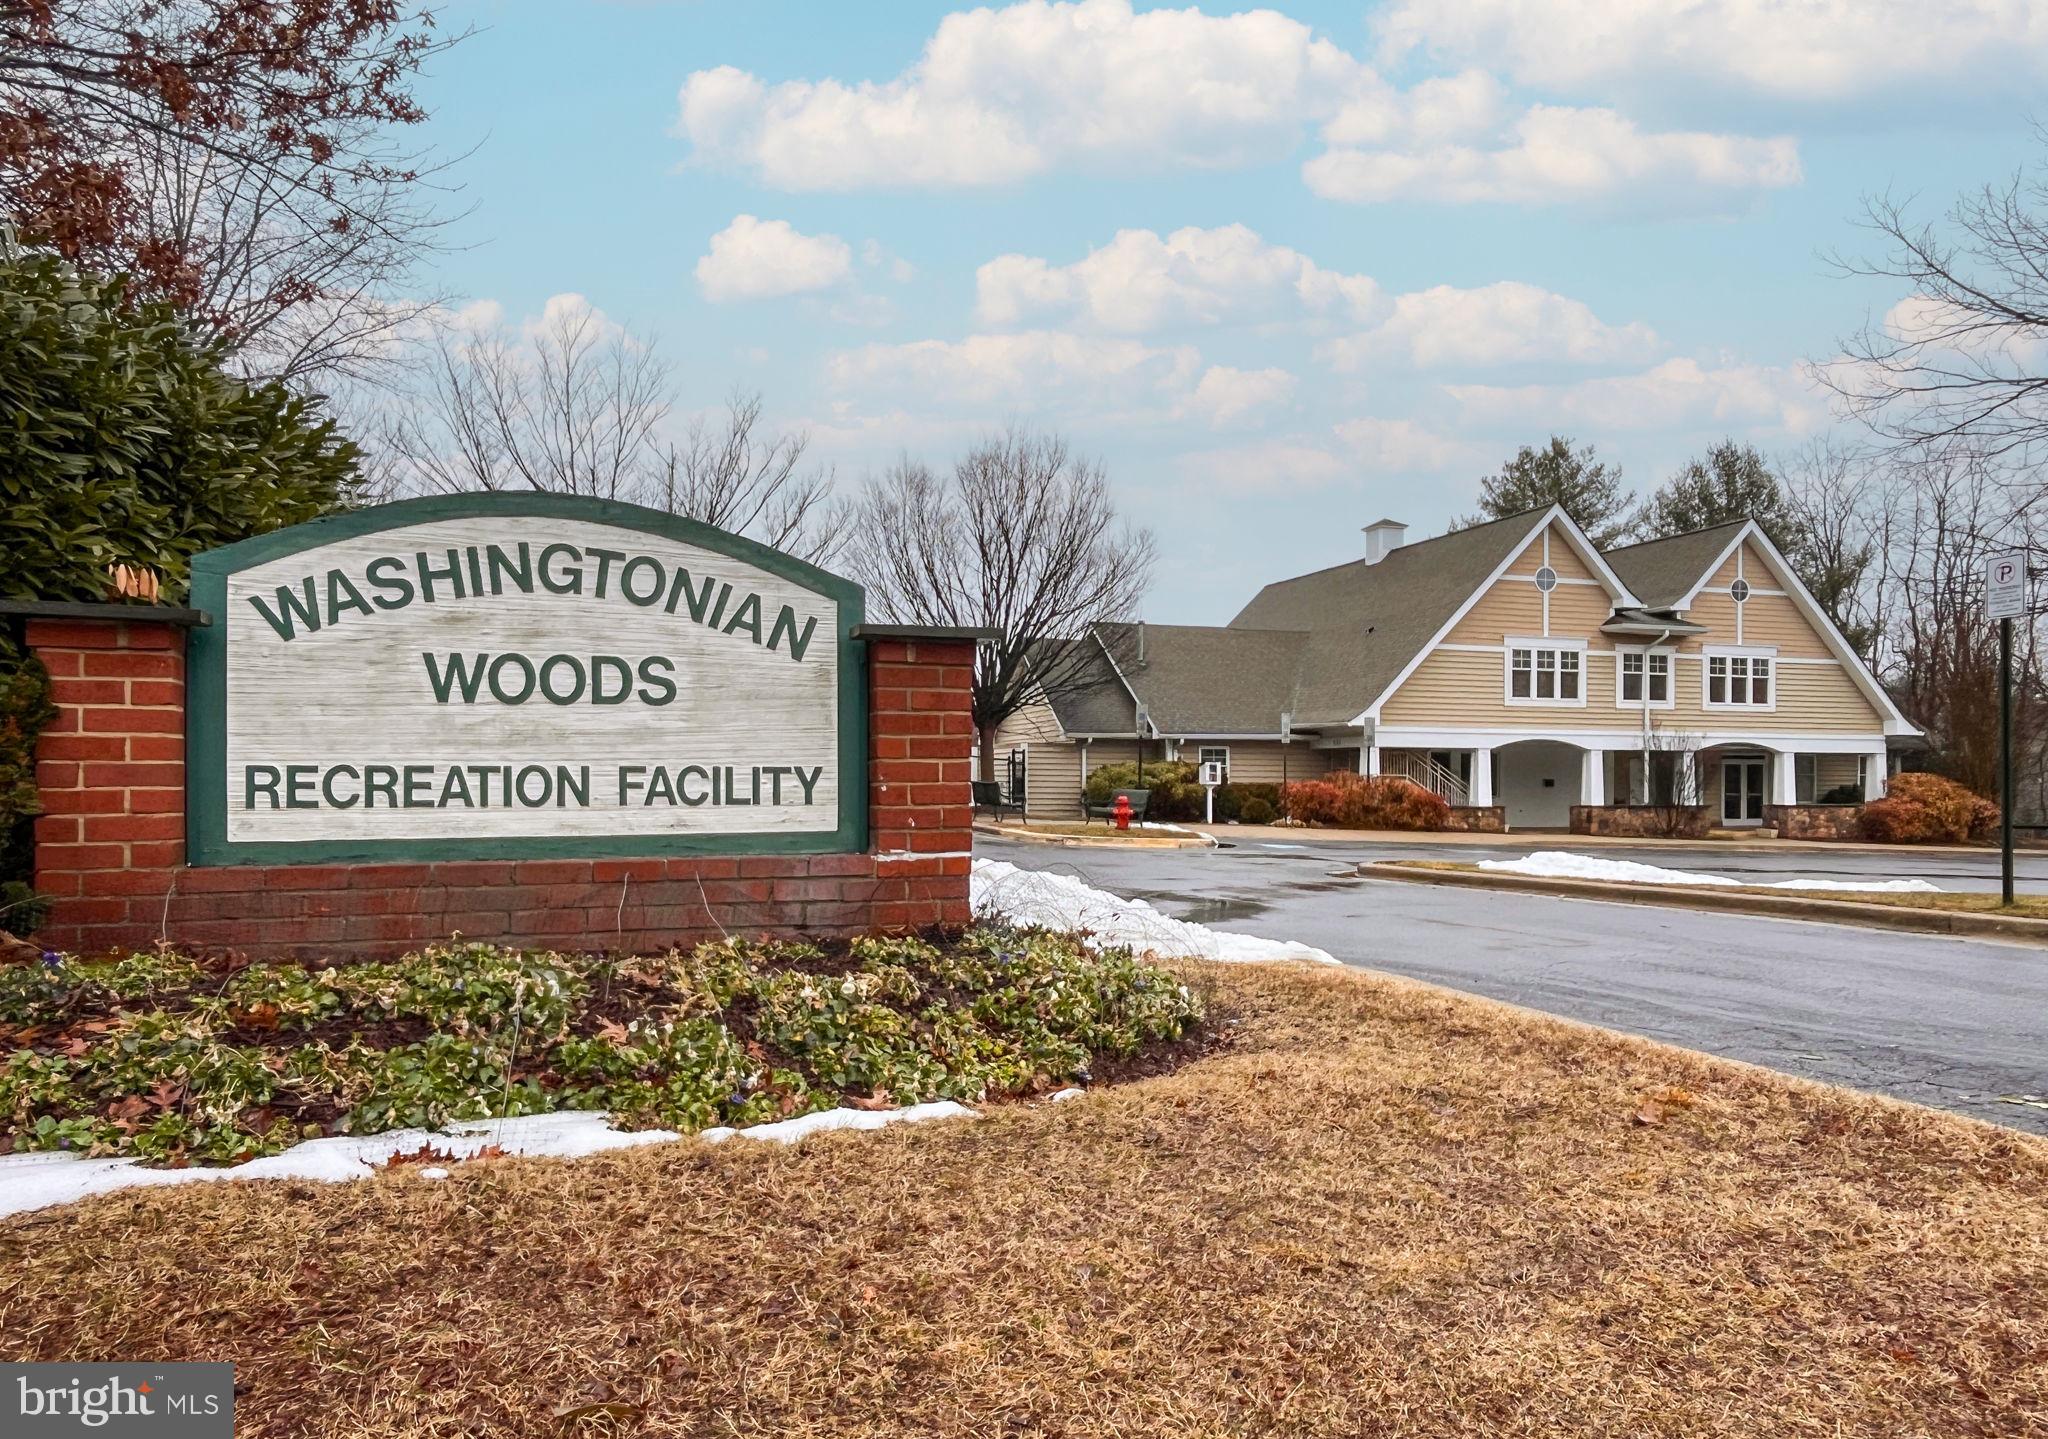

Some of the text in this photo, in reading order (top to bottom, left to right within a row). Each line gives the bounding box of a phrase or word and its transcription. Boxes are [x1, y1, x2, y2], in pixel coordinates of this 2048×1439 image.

[249, 541, 818, 662] WASHINGTONIAN
[423, 652, 677, 706] WOODS
[245, 764, 822, 809] RECREATION FACILITY
